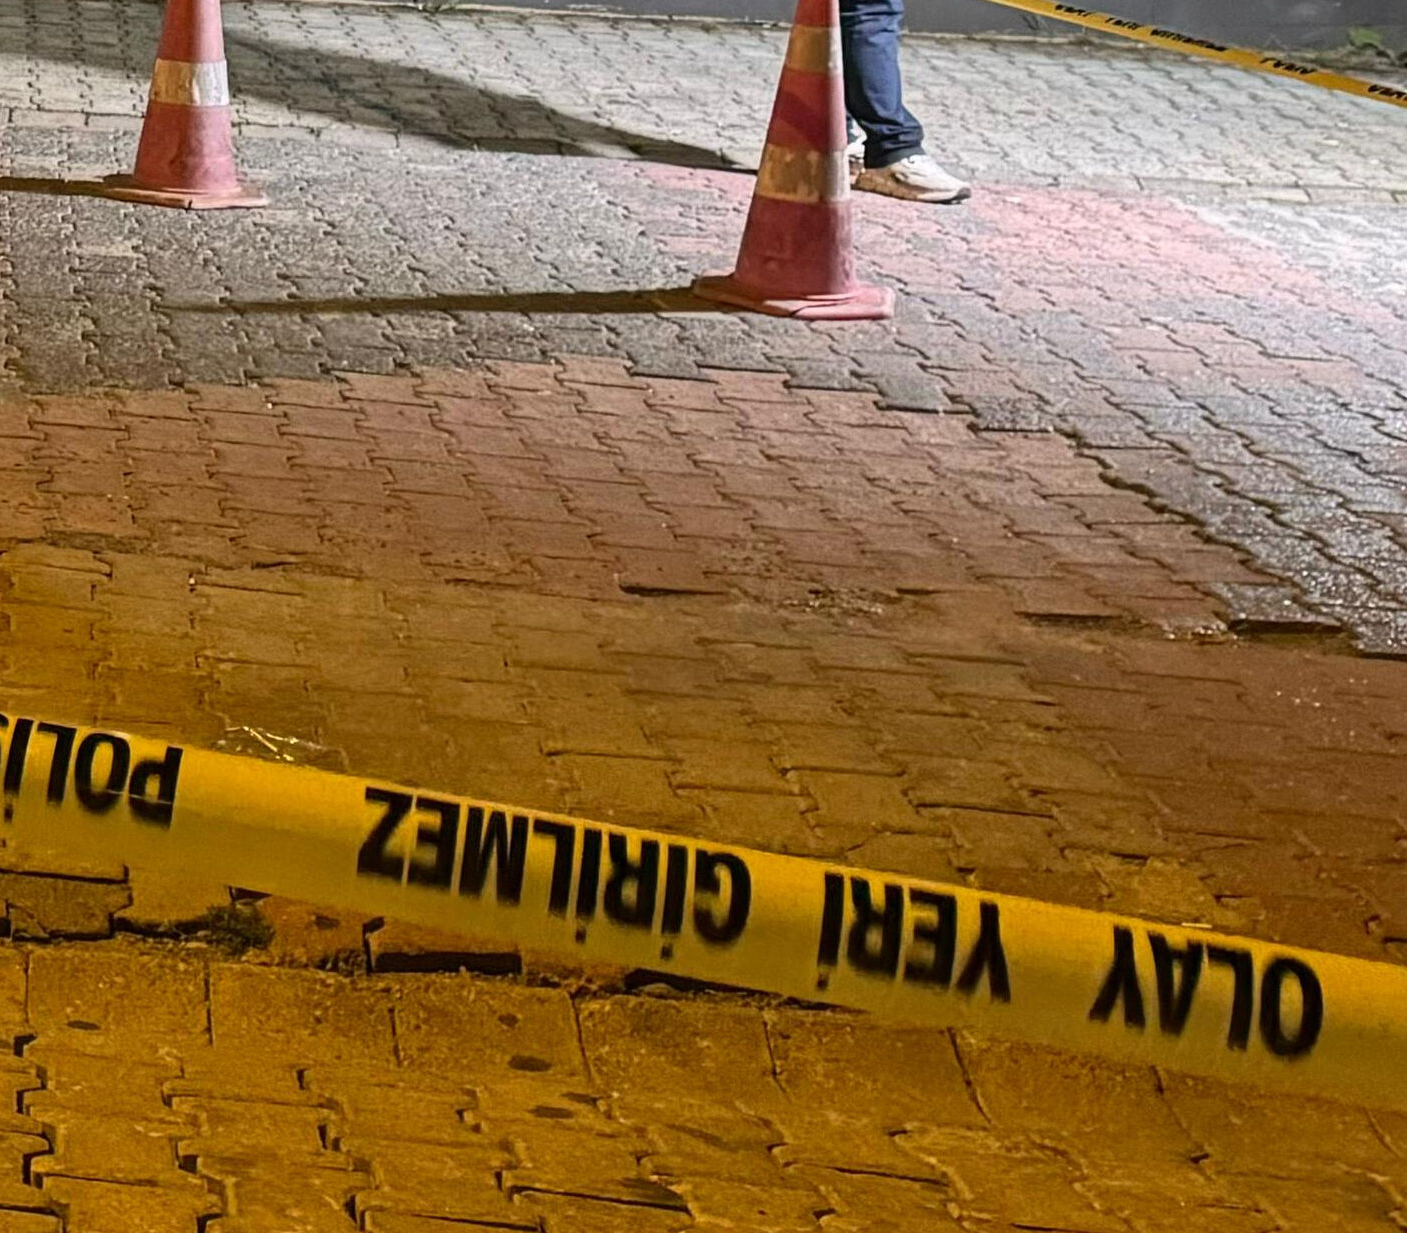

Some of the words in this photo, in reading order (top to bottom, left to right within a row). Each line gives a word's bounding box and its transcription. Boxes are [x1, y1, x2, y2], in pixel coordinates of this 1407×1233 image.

[355, 786, 752, 961] GİRİLMEZ
[817, 869, 1012, 1004] YERİ
[1087, 922, 1326, 1060] OLAY
